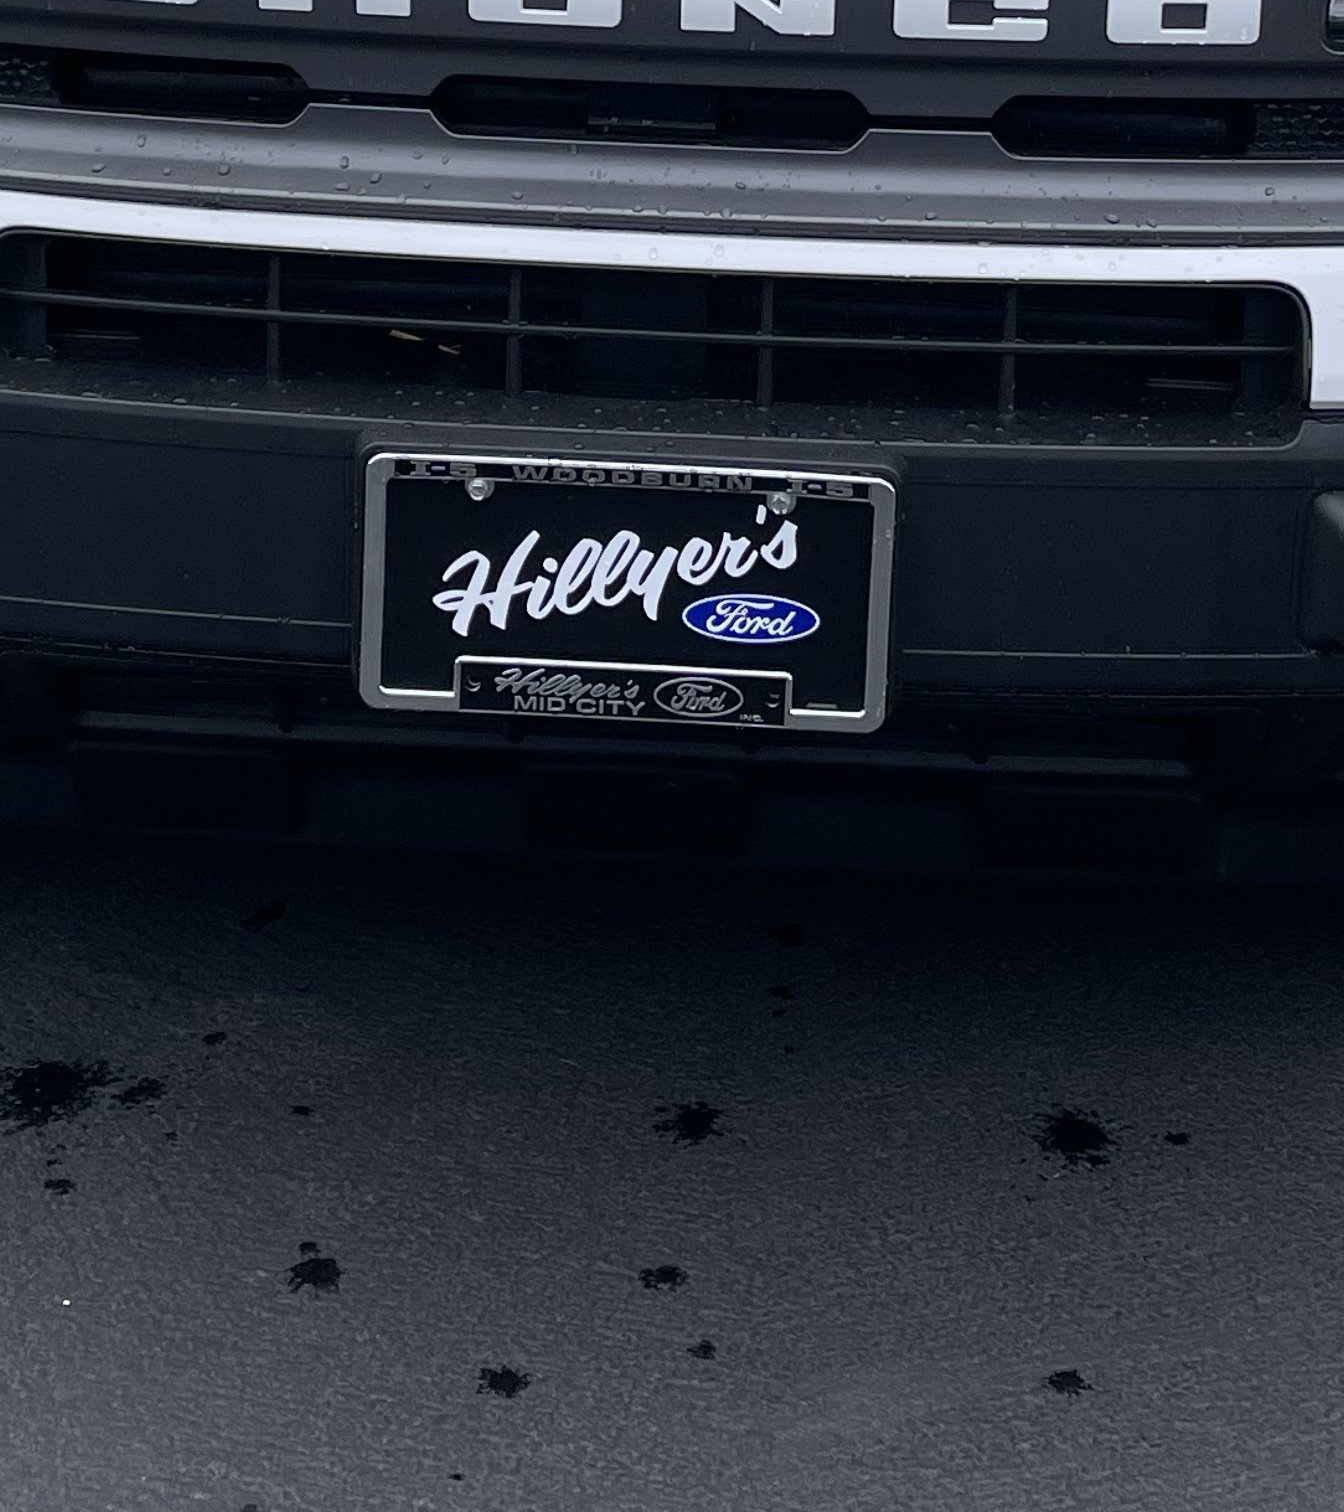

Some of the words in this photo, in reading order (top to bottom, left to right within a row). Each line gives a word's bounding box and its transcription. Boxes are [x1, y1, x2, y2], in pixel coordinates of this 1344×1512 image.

[409, 460, 478, 477] I-5
[511, 465, 753, 492] WOODBURN
[787, 478, 854, 498] I-5
[432, 503, 798, 637] Hillyer's
[706, 598, 794, 637] Ford
[494, 667, 640, 704] Hillyer's
[670, 683, 727, 712] Ford
[514, 694, 567, 712] MID
[576, 699, 647, 716] CITY
